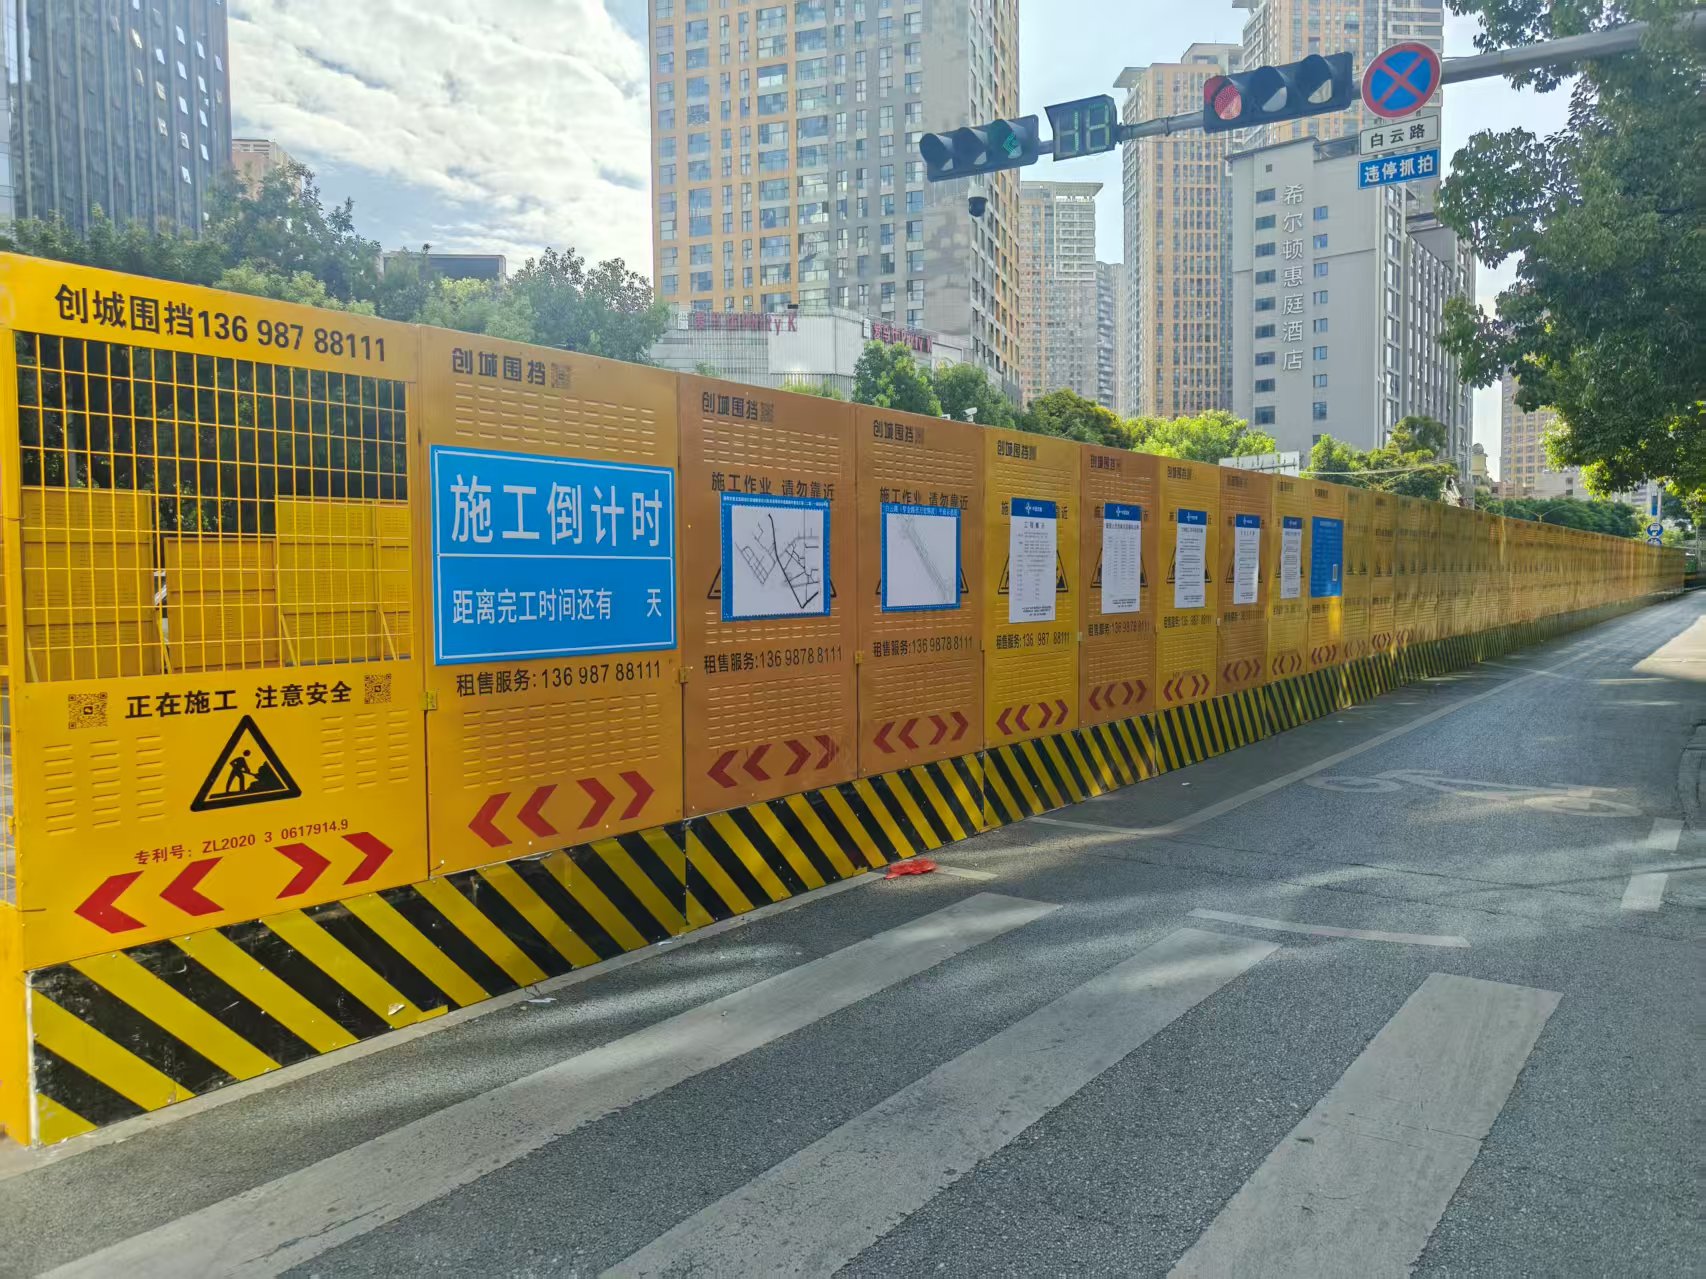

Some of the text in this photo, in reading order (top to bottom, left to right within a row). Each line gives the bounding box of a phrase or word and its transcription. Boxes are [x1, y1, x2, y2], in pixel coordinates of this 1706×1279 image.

[1371, 124, 1425, 148] 白云路
[1364, 154, 1433, 183] 违停抓拍
[1281, 184, 1304, 371] 希尔顿惠庭酒店
[257, 318, 303, 350] 987
[314, 327, 385, 362] 88111
[452, 347, 546, 385] 创城围挡
[702, 391, 758, 420] 创城围挡
[711, 471, 772, 495] 施工作业
[781, 479, 836, 501] 请勿靠近
[449, 473, 663, 547] 施工倒计时
[452, 588, 662, 625] 距离完工时间还有 天
[578, 664, 609, 685] 987
[615, 660, 661, 682] 88111
[785, 647, 814, 666] 9878
[817, 645, 842, 664] 8111
[125, 681, 352, 719] 正在施工 注意安全
[202, 834, 256, 855] ZL2020
[264, 831, 273, 844] 3
[281, 818, 349, 840] 0617914.9
